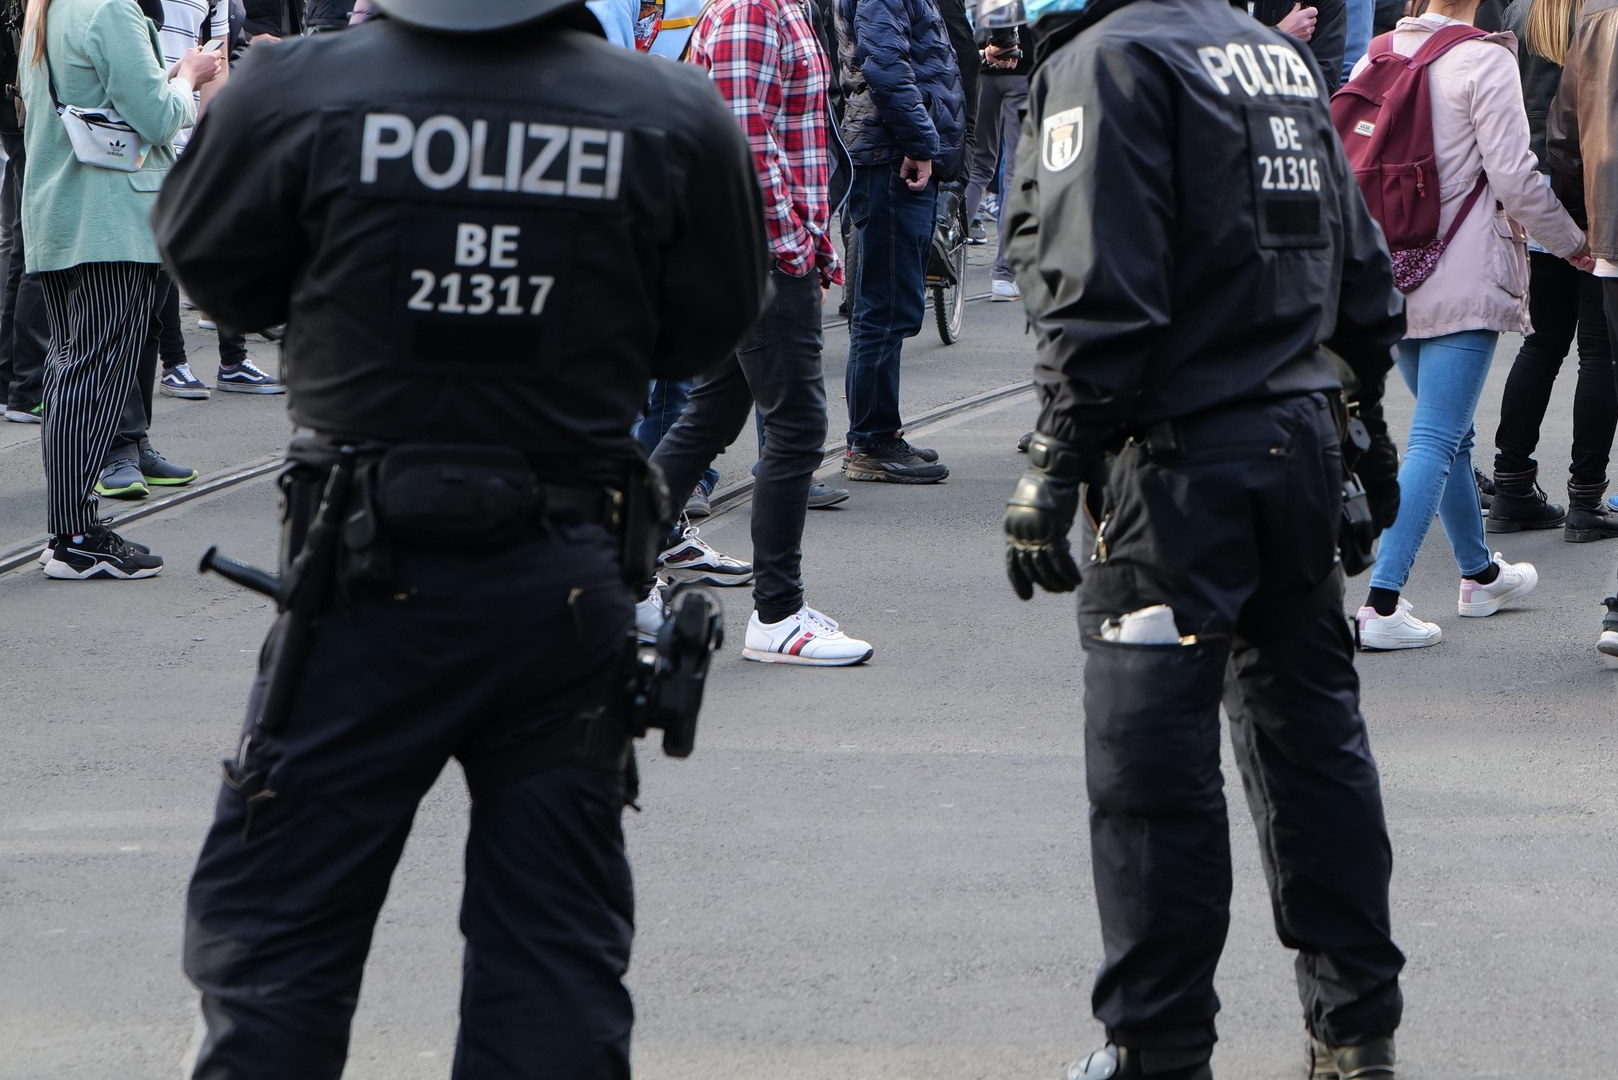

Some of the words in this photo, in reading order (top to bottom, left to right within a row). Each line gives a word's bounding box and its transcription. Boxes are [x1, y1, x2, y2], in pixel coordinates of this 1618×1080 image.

[1197, 43, 1319, 98] POLIZEI
[1269, 116, 1302, 150] BE
[360, 113, 624, 200] POLIZEI
[1258, 155, 1320, 191] 21316
[455, 223, 520, 268] BE
[407, 270, 555, 315] 21317
